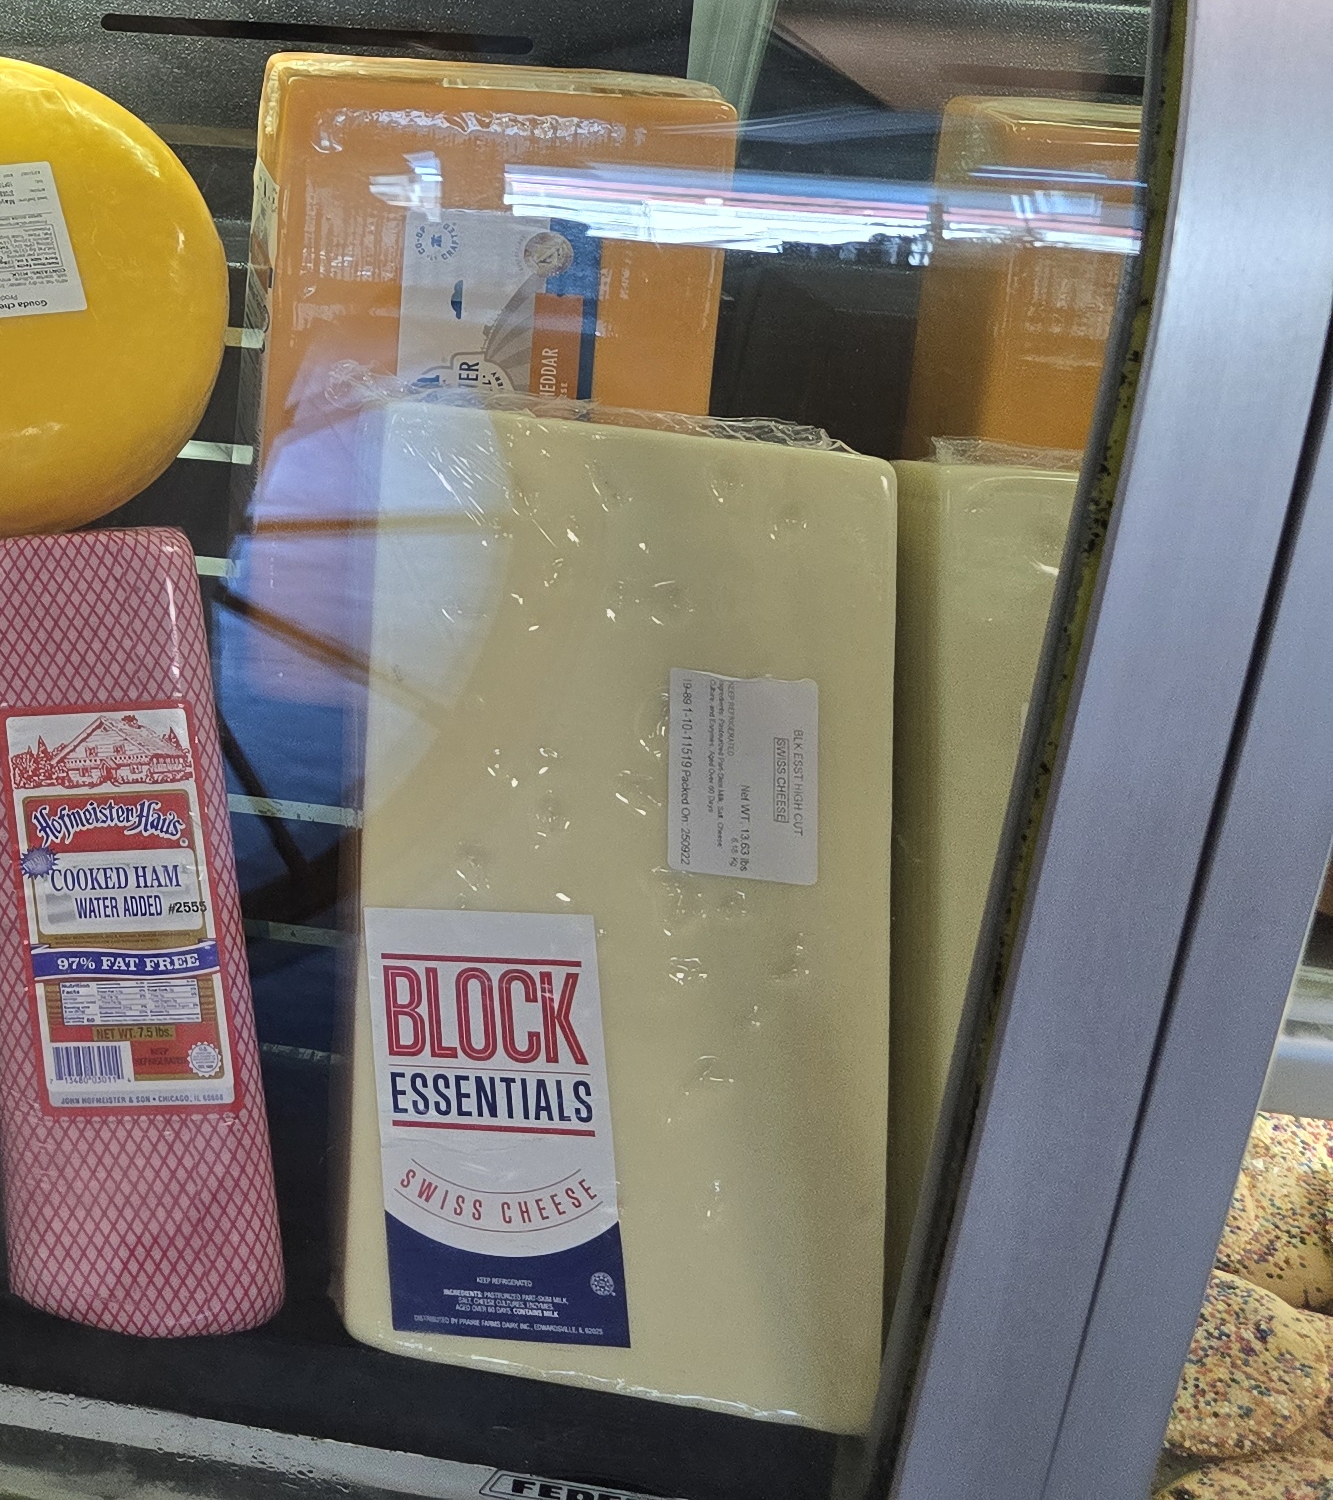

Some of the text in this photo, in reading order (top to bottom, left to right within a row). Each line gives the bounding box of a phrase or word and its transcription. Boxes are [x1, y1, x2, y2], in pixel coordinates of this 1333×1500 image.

[17, 299, 48, 307] Gouda
[776, 738, 787, 821] SWISS CHEESE
[793, 729, 804, 837] BLK ESST HIGH CUT
[33, 800, 133, 844] Hofmeister
[681, 770, 691, 866] Packed On: 250922
[740, 828, 750, 857] 13.63
[50, 863, 183, 891] COOKED HAM
[740, 858, 750, 872] lbs
[75, 894, 208, 919] WATER ADDED #2555
[56, 953, 200, 972] 97% FAT FREE
[95, 1026, 173, 1040] NET 7.5 lbs.
[383, 964, 589, 1066] BLOCK
[390, 1072, 593, 1123] ESSENTIALS
[400, 1169, 597, 1224] SWISS CHEESE
